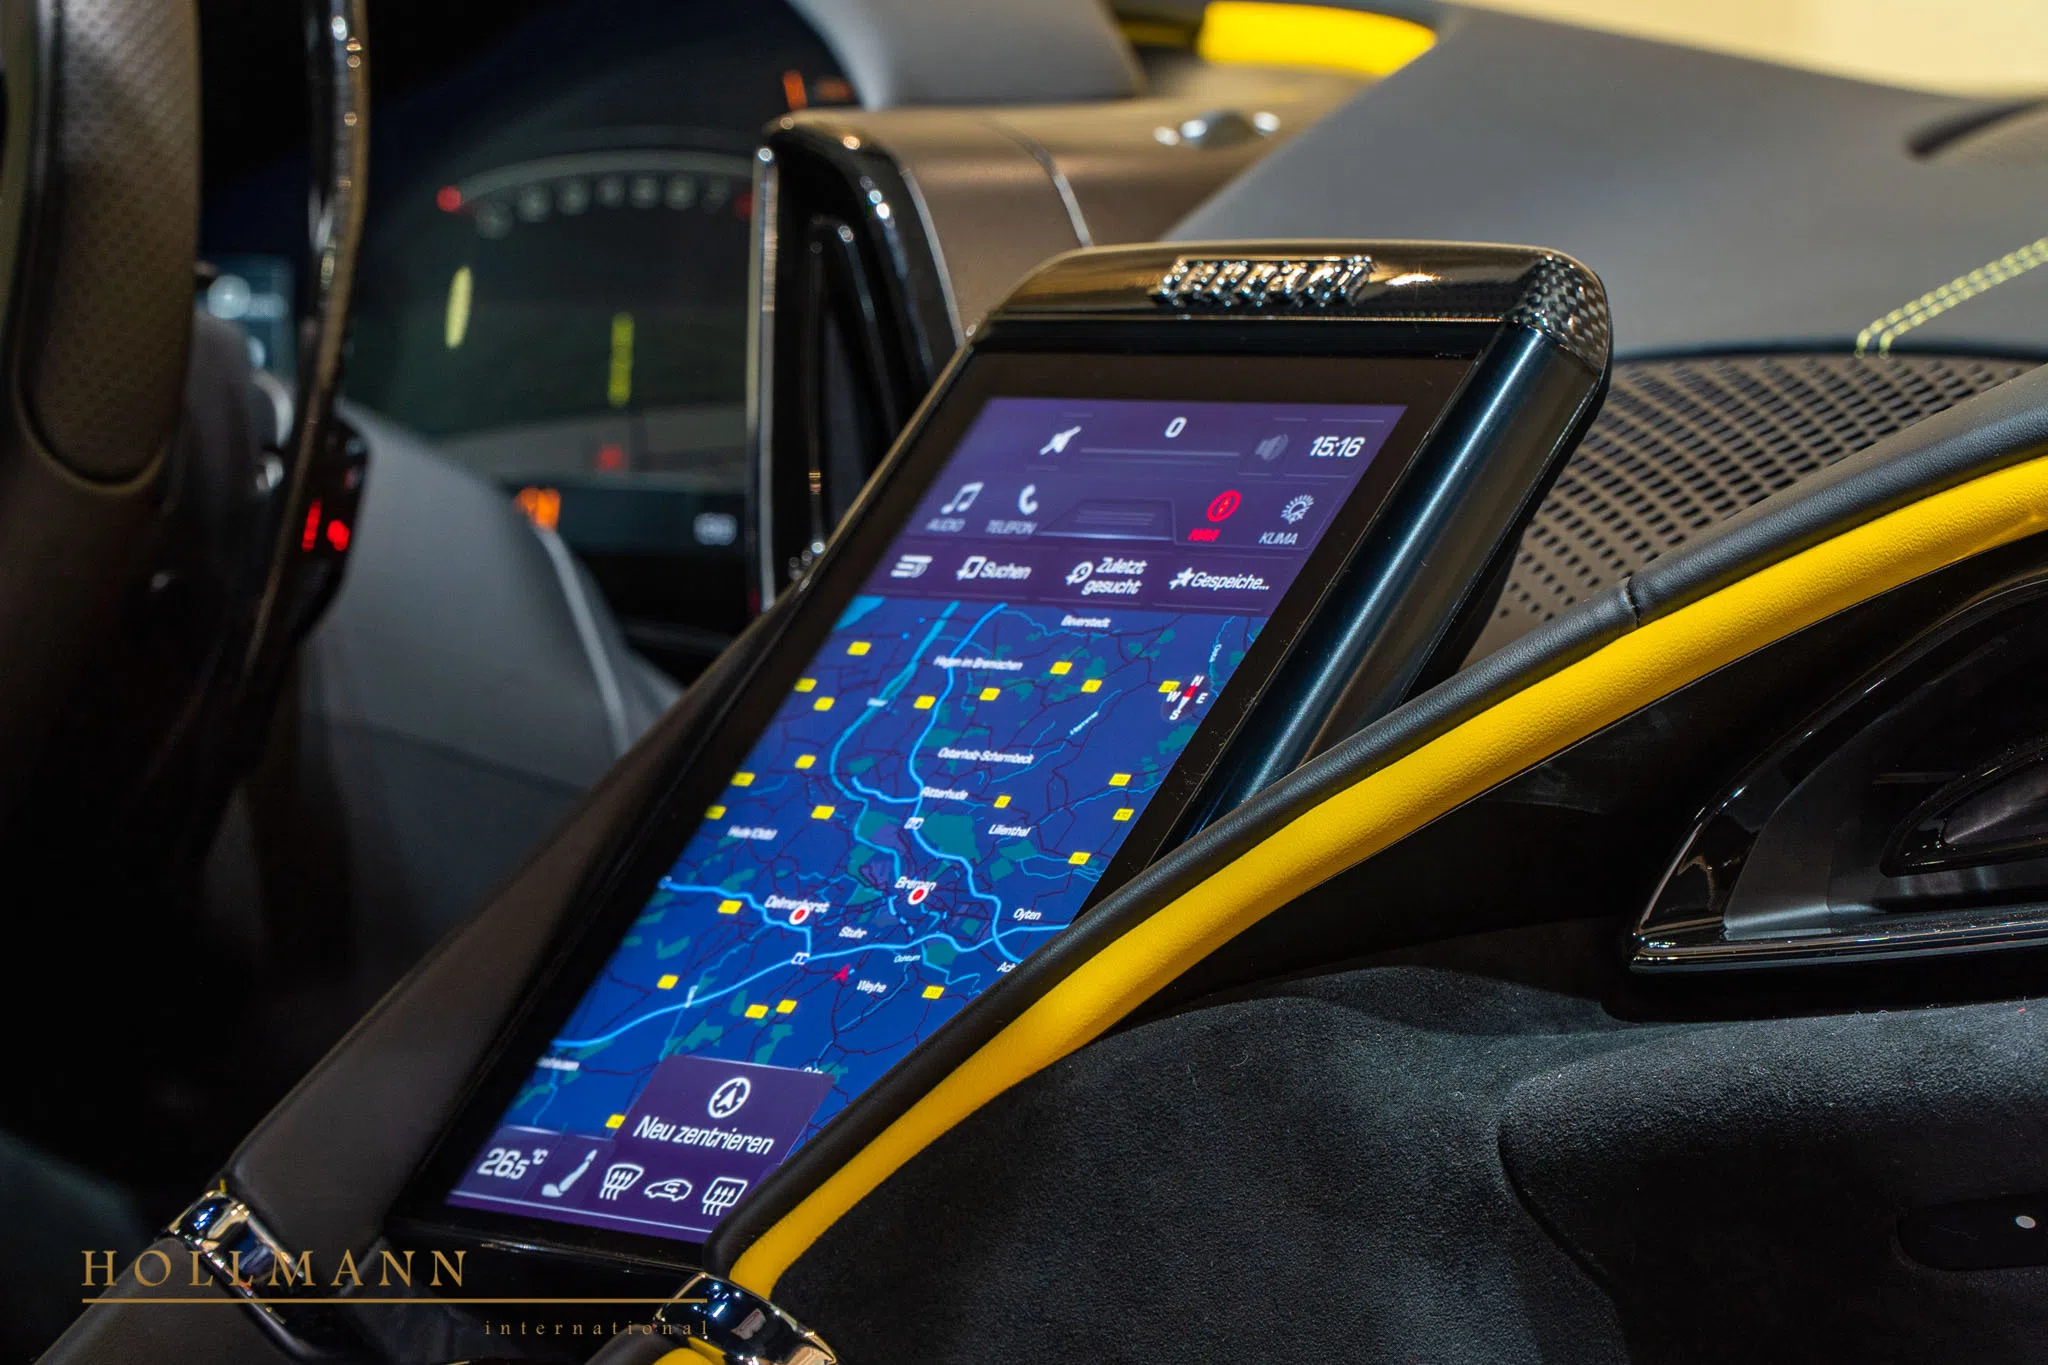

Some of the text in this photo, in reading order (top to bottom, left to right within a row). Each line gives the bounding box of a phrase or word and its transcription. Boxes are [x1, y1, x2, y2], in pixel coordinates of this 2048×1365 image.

[1309, 436, 1365, 457] 15:16
[985, 520, 1037, 535] TELEFON
[1258, 531, 1298, 545] KLIMA
[979, 562, 1031, 580] Suchen
[1096, 557, 1147, 575] Zuletzt
[1081, 578, 1142, 596] gesucht
[1191, 572, 1270, 591] Gespeiche...
[1190, 675, 1204, 687] N
[1166, 691, 1181, 702] W
[1196, 692, 1208, 704] E
[1169, 709, 1181, 721] S
[988, 824, 1031, 837] Lilienthal
[1013, 908, 1042, 921] Oyten
[838, 926, 868, 939] Stuhr
[856, 980, 888, 994] Weyhe
[632, 1115, 775, 1156] Neu zentrieren
